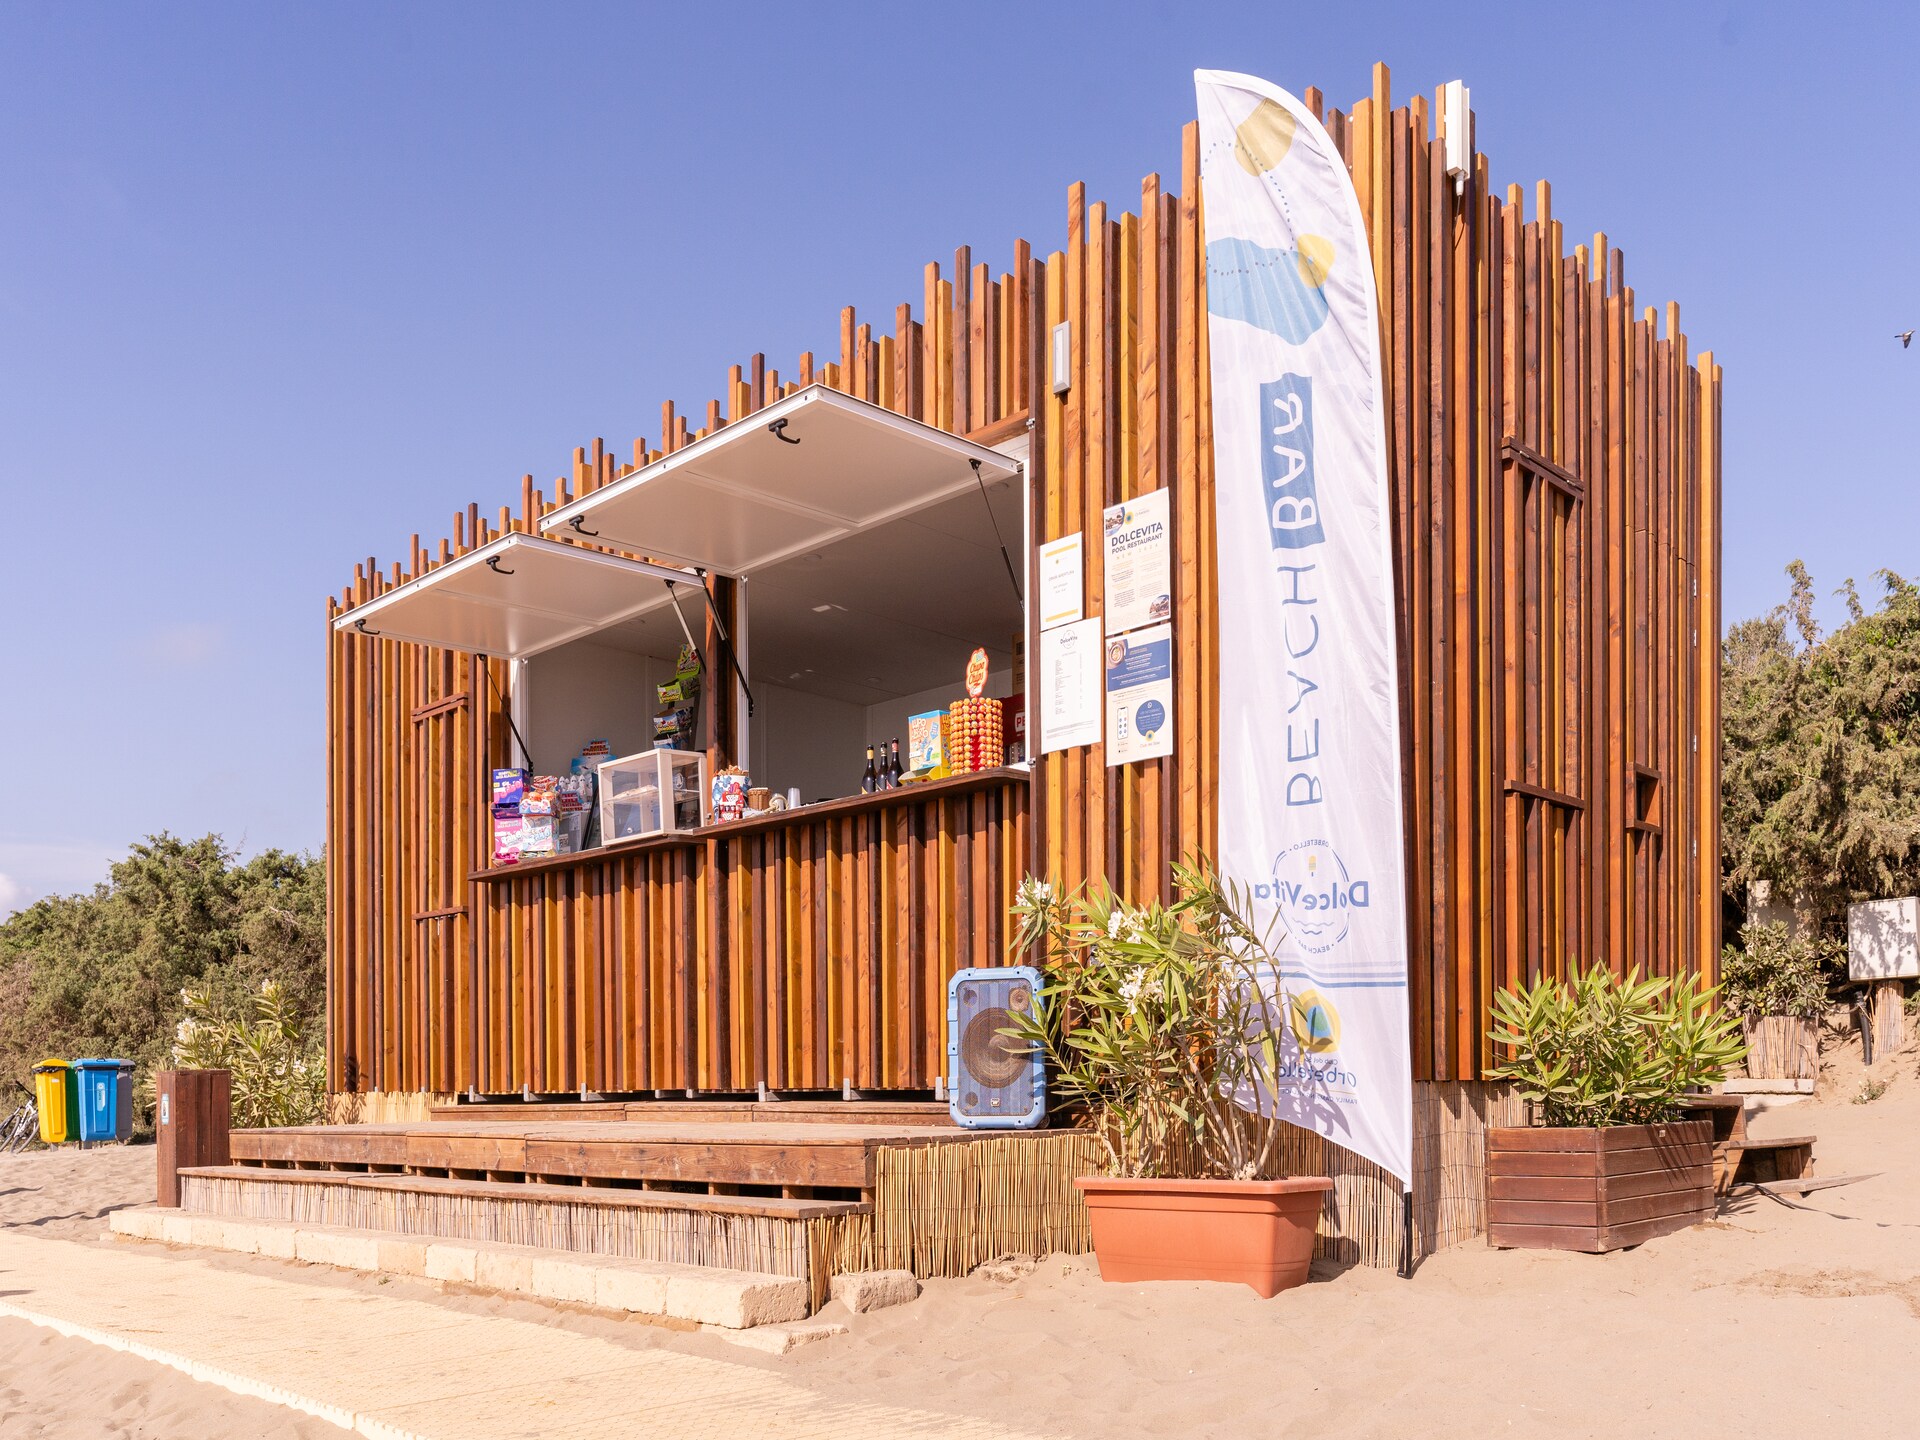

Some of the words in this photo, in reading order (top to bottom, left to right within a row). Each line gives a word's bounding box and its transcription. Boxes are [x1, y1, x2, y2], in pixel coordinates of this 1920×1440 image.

[1111, 521, 1163, 547] DOLCEVITA
[1111, 545, 1126, 555] POOL
[1127, 532, 1163, 549] RESTAURANT
